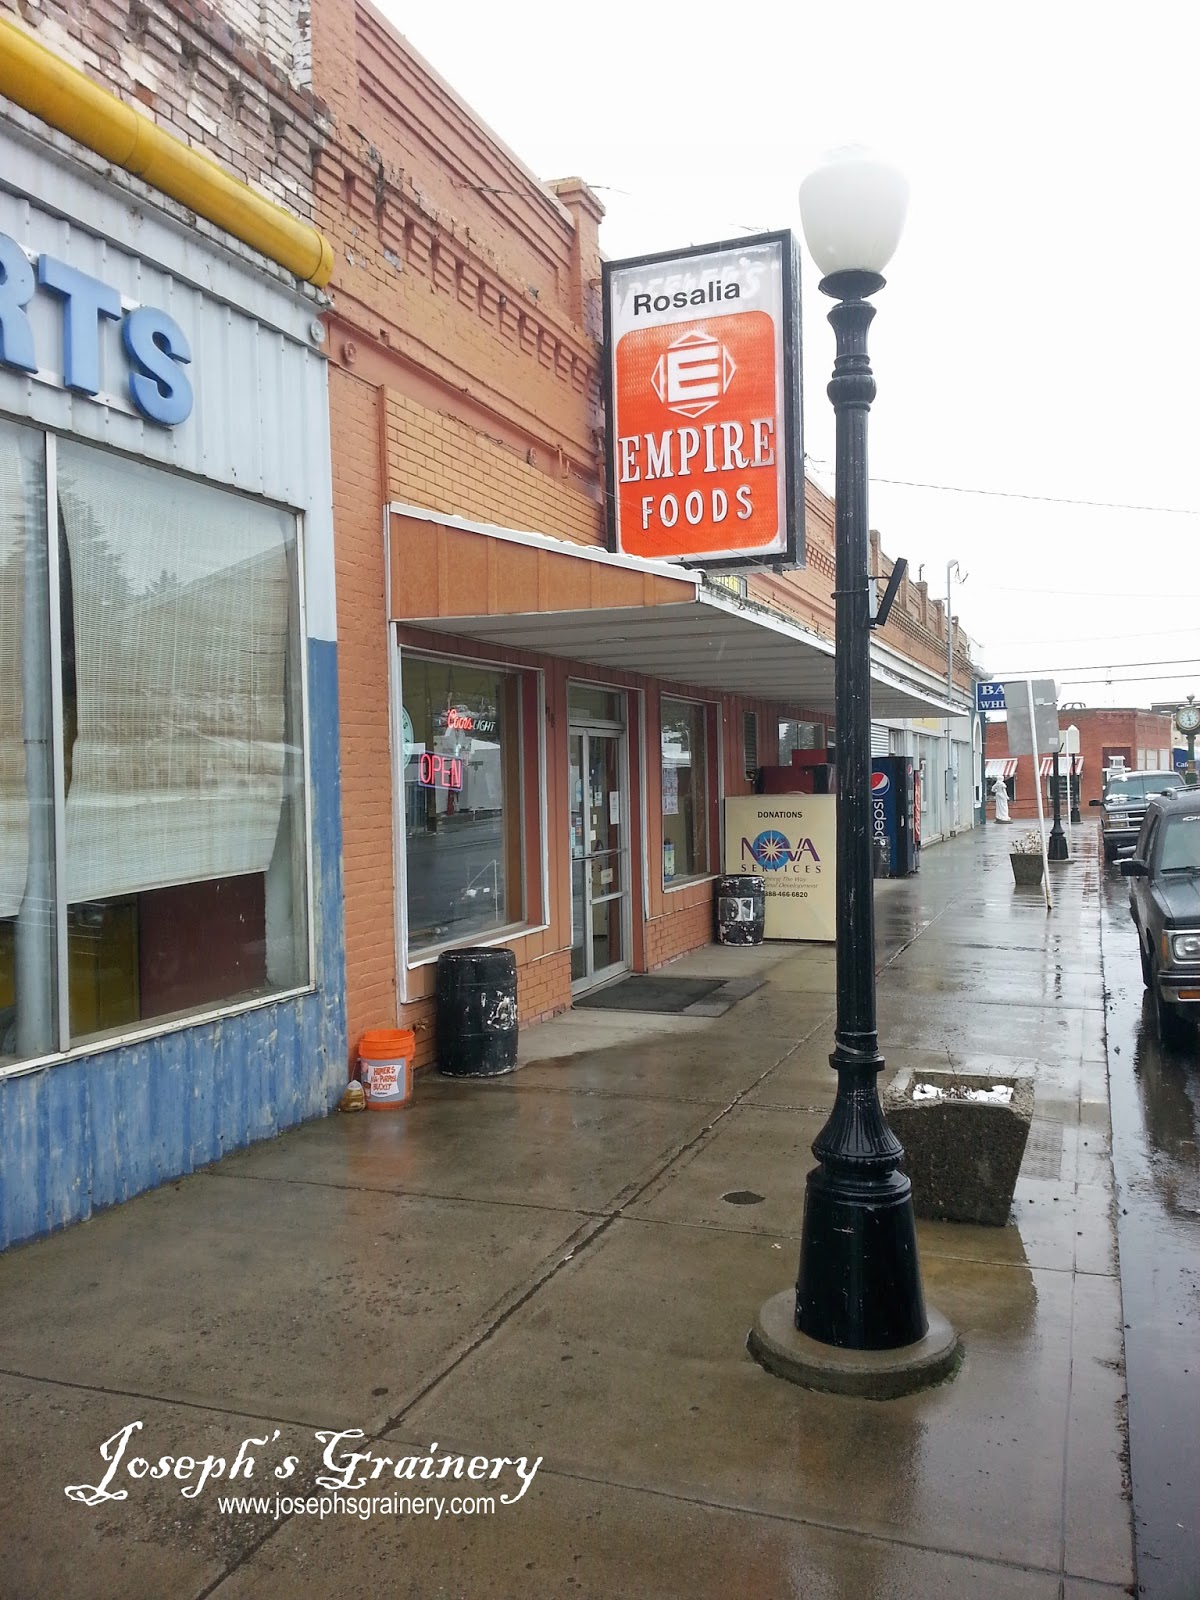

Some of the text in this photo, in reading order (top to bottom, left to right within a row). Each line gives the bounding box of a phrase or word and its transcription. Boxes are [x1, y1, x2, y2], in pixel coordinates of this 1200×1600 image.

[633, 279, 741, 316] Rosalia
[618, 418, 776, 484] EMPIRE
[641, 484, 753, 530] FOODS
[473, 719, 496, 732] LIGHT
[420, 754, 461, 788] OPEN
[741, 863, 822, 873] SERVICES
